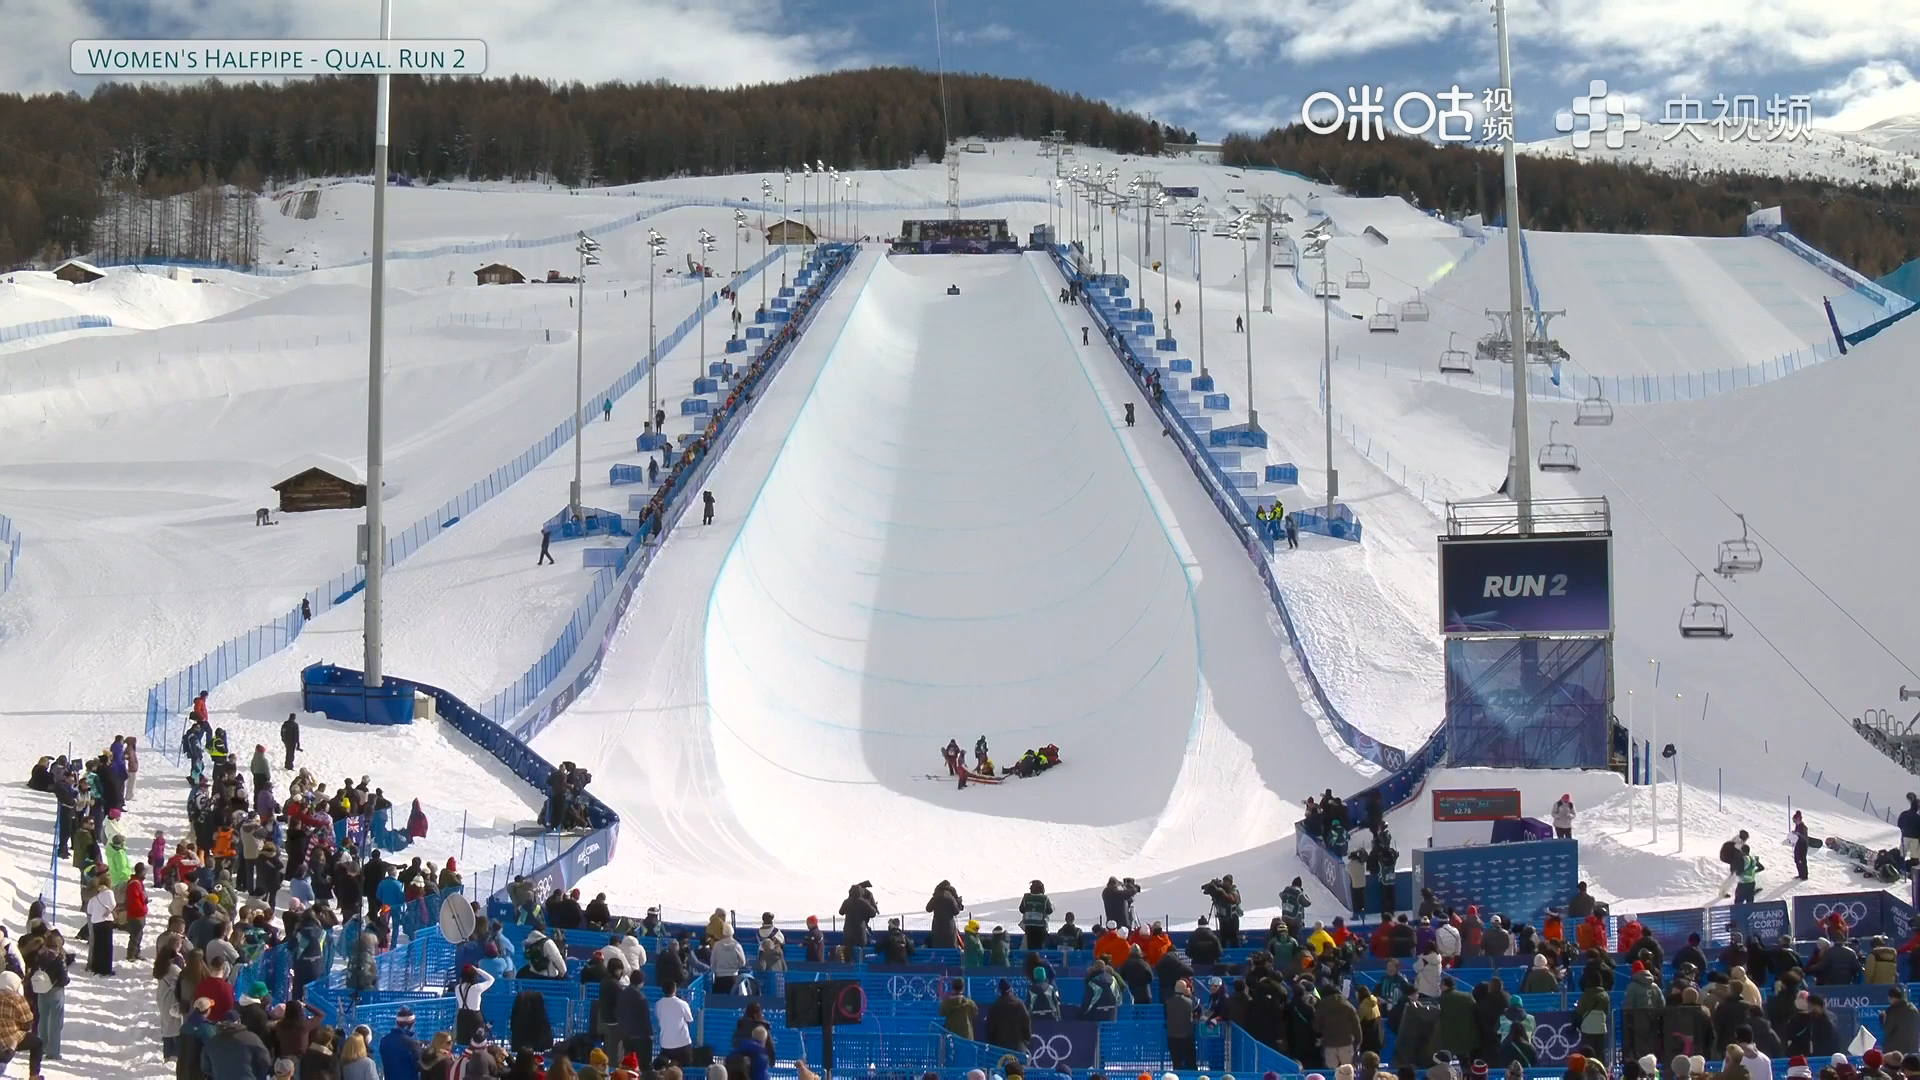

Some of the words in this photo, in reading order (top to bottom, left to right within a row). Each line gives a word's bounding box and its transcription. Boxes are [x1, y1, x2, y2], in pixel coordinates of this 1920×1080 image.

[1483, 574, 1546, 598] RUN
[1549, 573, 1568, 596] 2
[1747, 909, 1784, 920] MILANO
[1760, 928, 1779, 938] 2026
[1824, 996, 1870, 1008] MILANO
